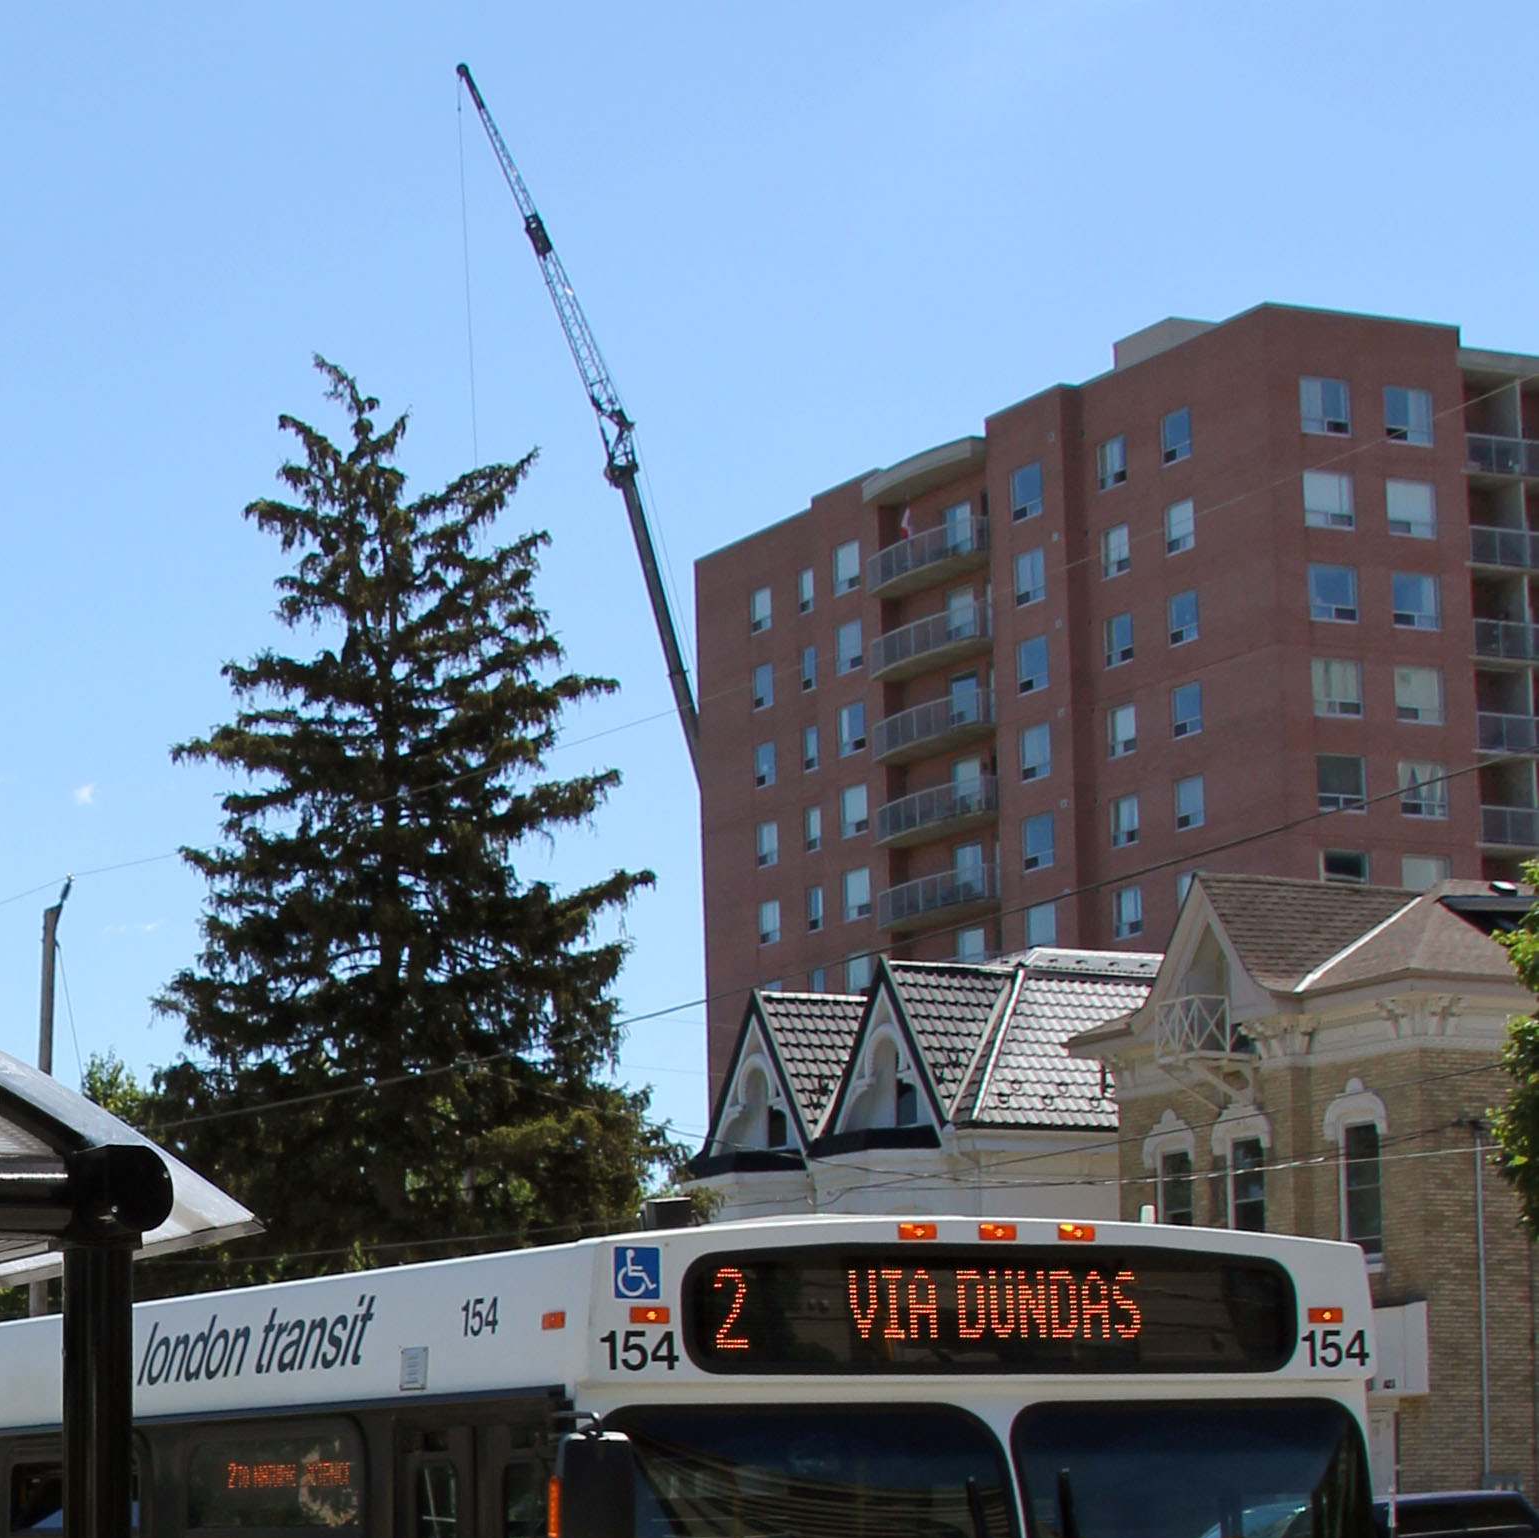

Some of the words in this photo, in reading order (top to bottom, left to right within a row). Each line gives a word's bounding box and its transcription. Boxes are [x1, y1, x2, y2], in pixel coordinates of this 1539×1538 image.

[461, 1296, 498, 1338] 154
[713, 1267, 749, 1351] 2
[847, 1269, 938, 1341] VIA
[955, 1270, 1142, 1341] DUNDAS
[137, 1314, 250, 1386] london
[255, 1294, 375, 1374] transit
[600, 1332, 679, 1372] 154
[1300, 1331, 1370, 1369] 154
